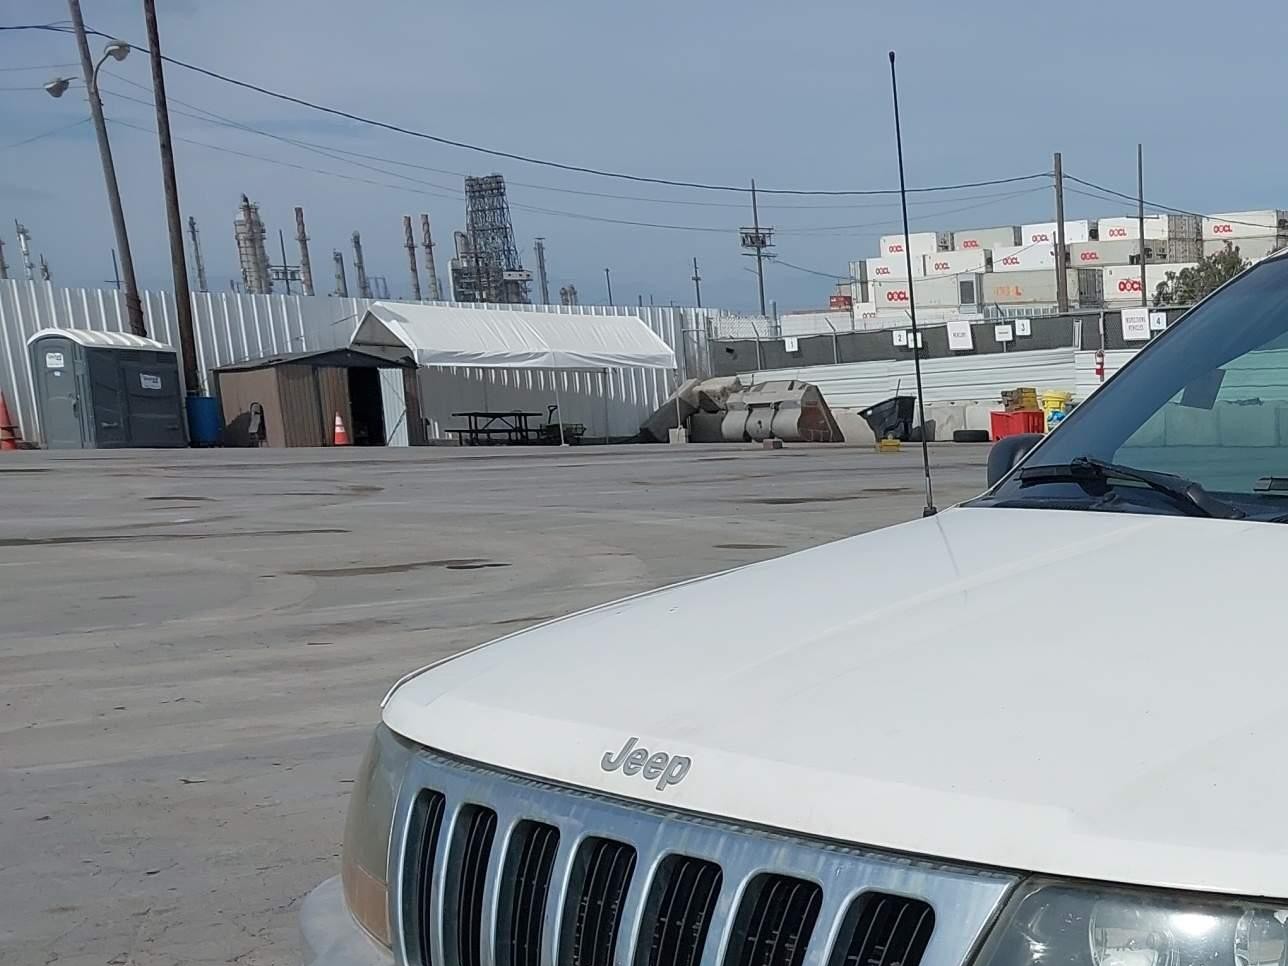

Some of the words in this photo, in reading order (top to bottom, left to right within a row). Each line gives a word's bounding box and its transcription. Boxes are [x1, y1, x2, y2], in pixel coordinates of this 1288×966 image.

[1109, 228, 1127, 237] OOCL
[1213, 225, 1233, 233] OOCL
[1032, 234, 1049, 242] OOCL
[963, 240, 979, 248] OOCL
[1081, 252, 1099, 260] OOCL
[1002, 256, 1020, 265] OOCL
[886, 291, 909, 301] OOCL
[601, 737, 692, 791] Jeep
